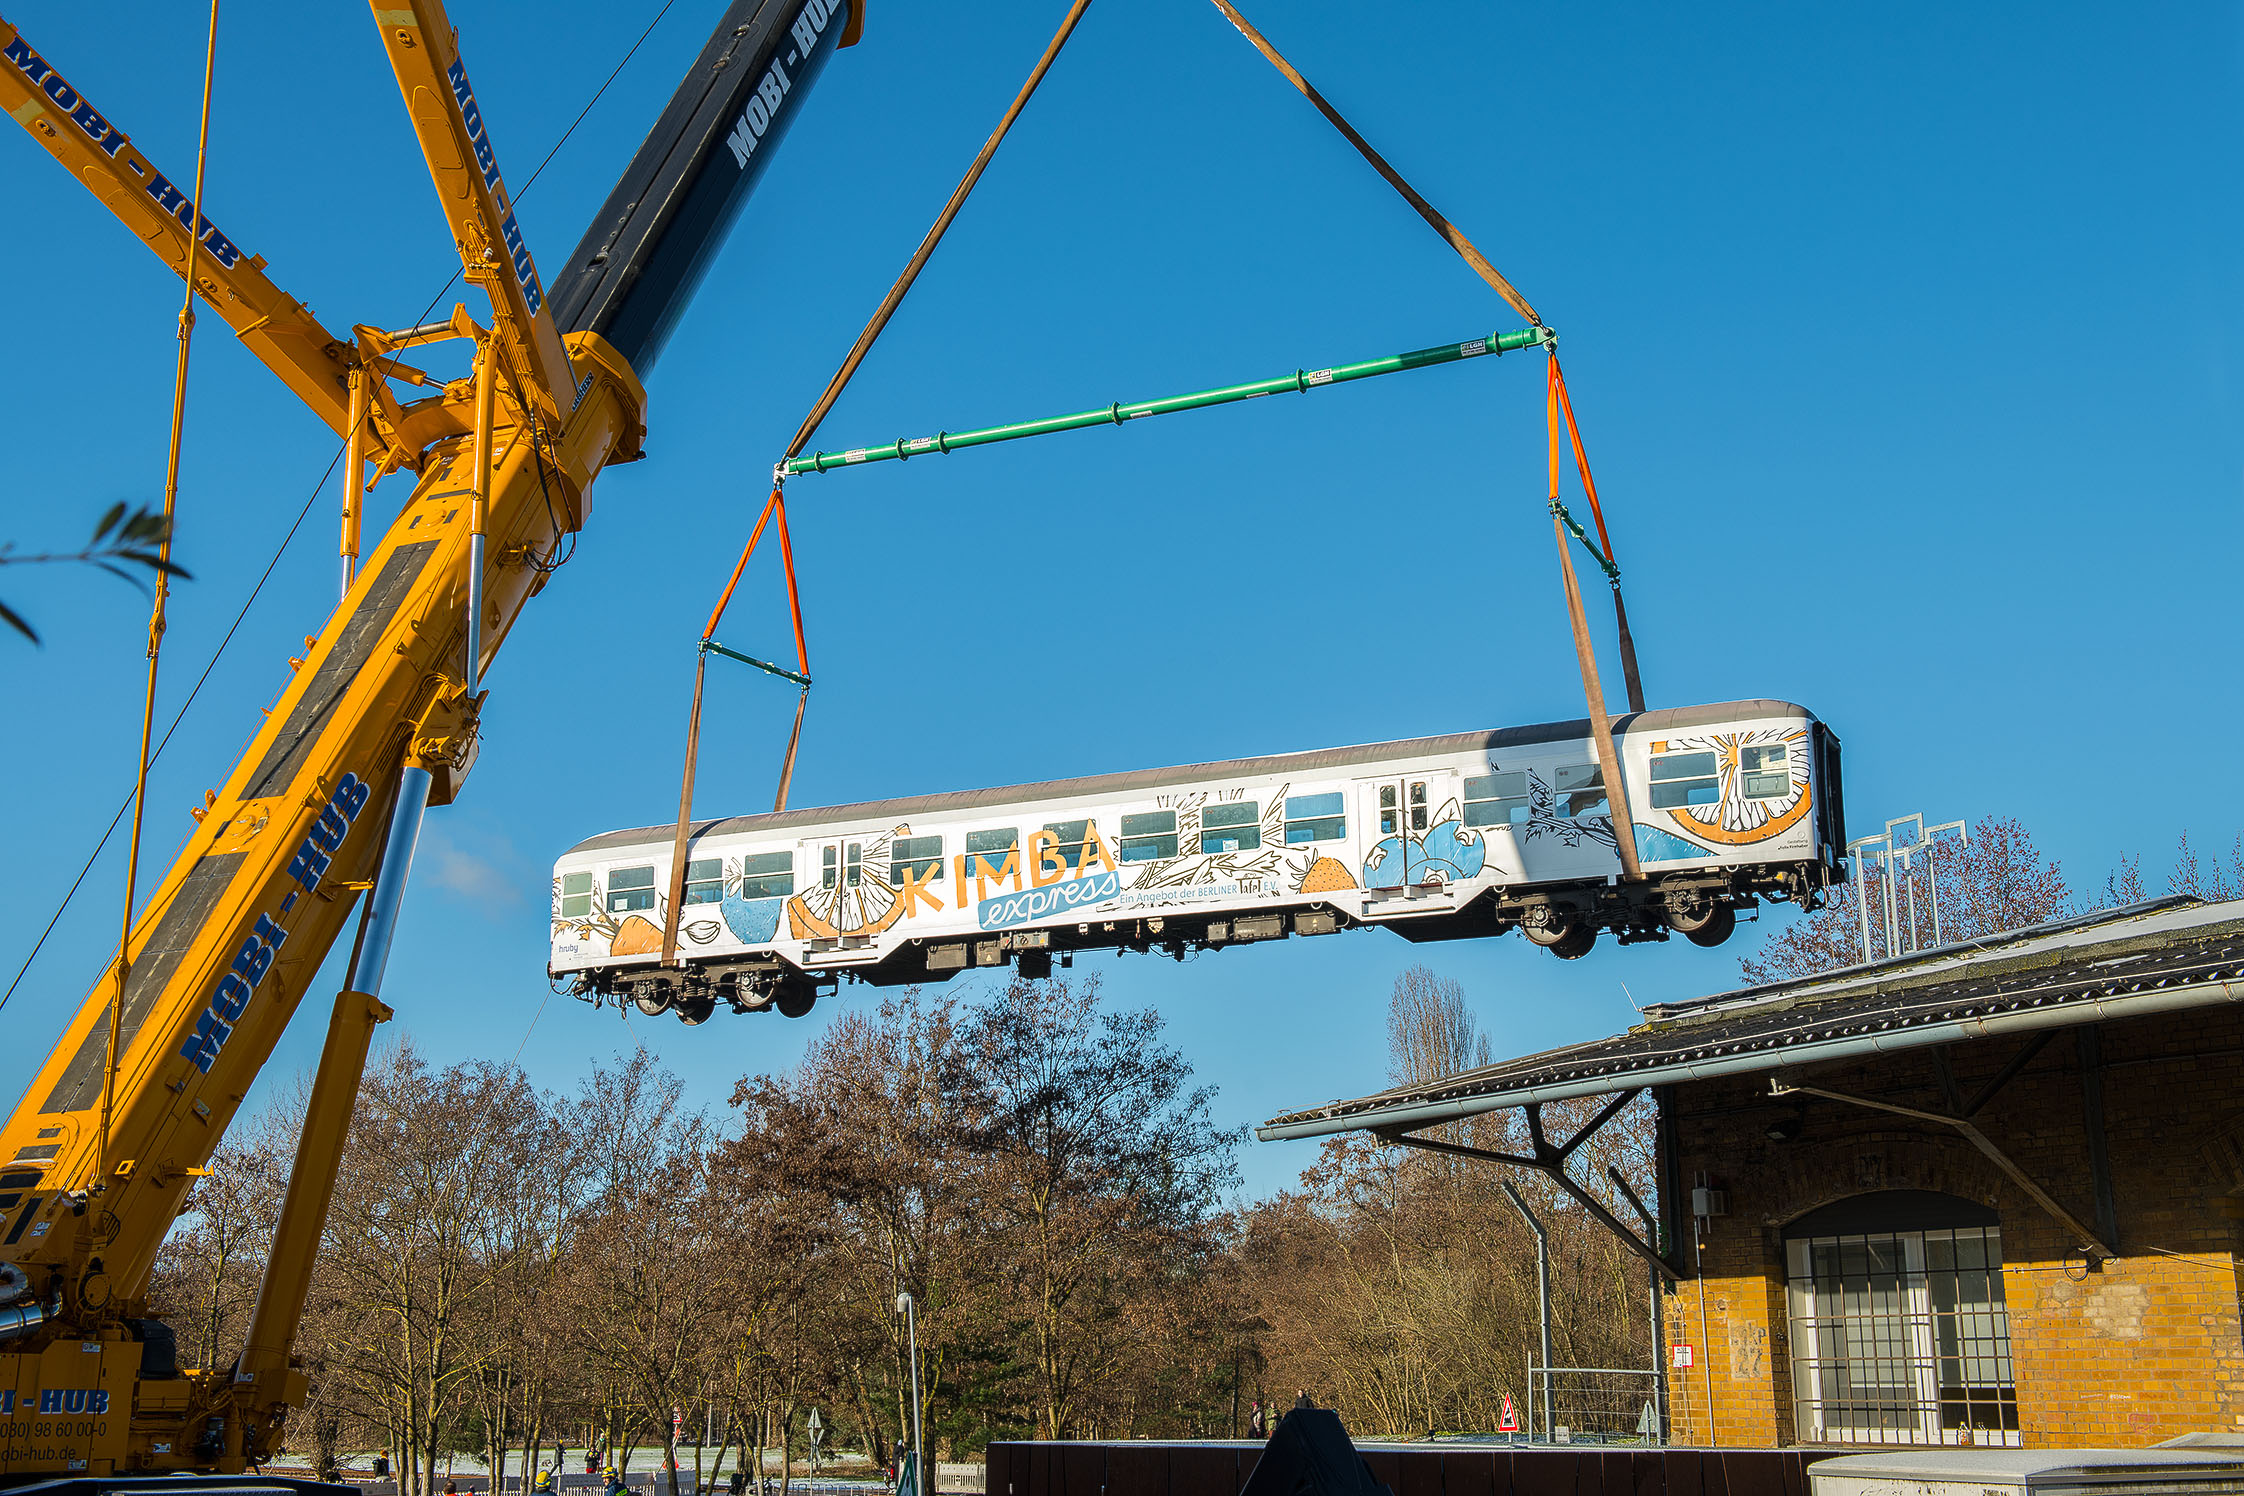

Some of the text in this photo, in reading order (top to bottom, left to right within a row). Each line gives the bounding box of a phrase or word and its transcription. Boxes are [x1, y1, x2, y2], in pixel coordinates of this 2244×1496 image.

[726, 57, 791, 169] MOBI
[3, 36, 126, 159] MOBI
[146, 173, 240, 270] HUB
[448, 55, 500, 194] MOBI
[502, 211, 541, 318] HUB
[901, 818, 1117, 919] KIMBA
[982, 872, 1117, 927] express
[1120, 894, 1134, 904] Ein
[1136, 890, 1177, 904] Angebot
[1179, 888, 1195, 899] der
[1198, 884, 1238, 897] BERLINER
[1236, 877, 1263, 895] Tafel
[179, 912, 289, 1075] MOBI
[287, 772, 371, 893] HUB
[559, 944, 579, 953] hruby
[0, 1389, 15, 1414] I
[39, 1389, 110, 1414] HUB
[34, 1422, 51, 1437] 98
[55, 1422, 73, 1437] 60
[76, 1422, 107, 1437] 00-0
